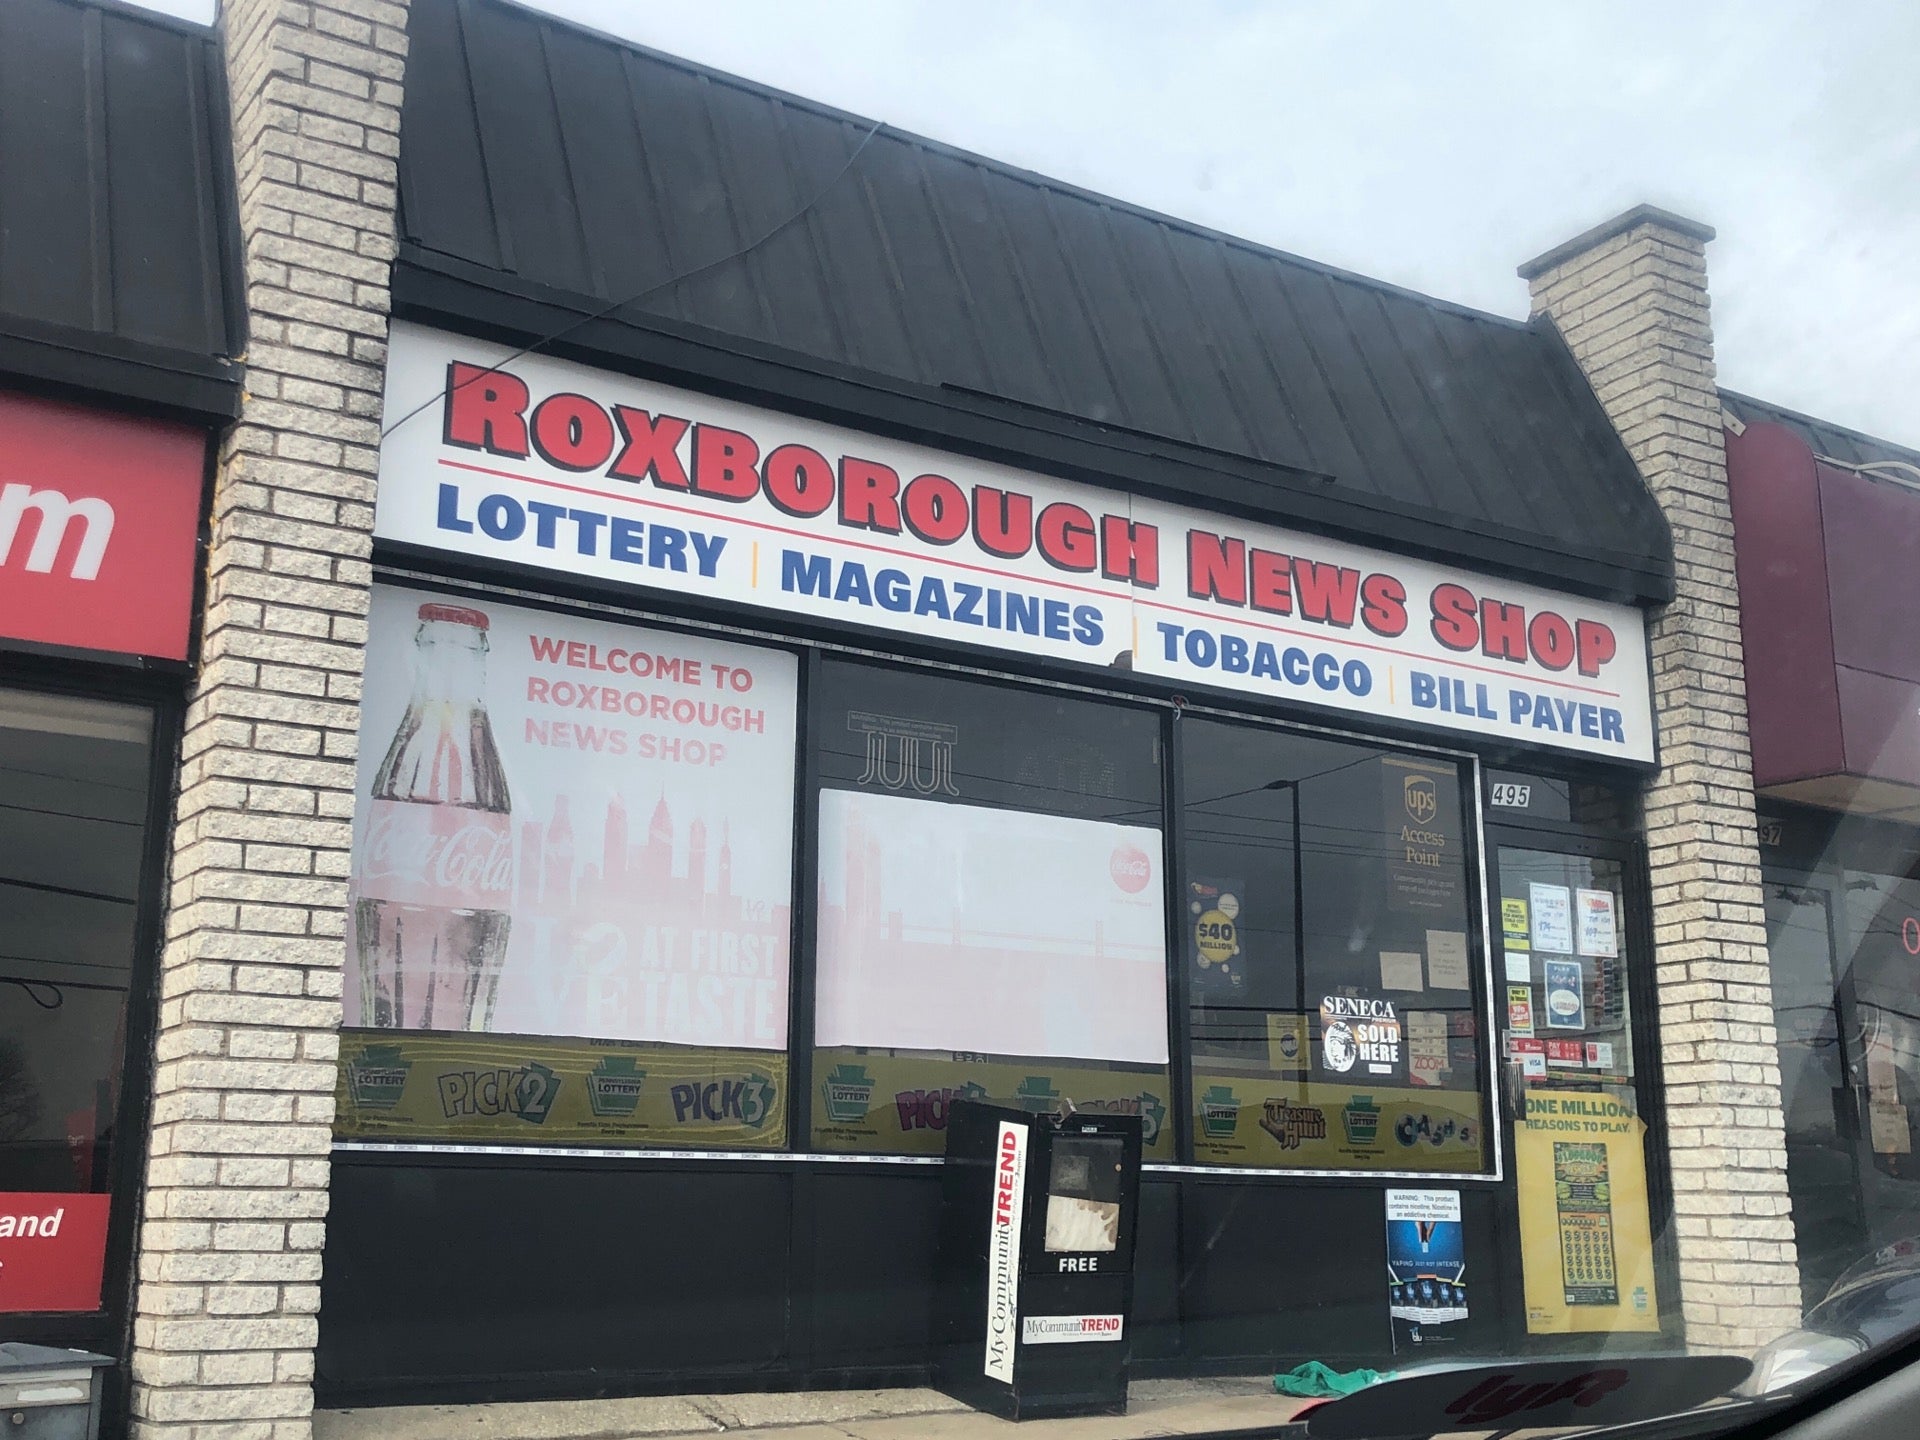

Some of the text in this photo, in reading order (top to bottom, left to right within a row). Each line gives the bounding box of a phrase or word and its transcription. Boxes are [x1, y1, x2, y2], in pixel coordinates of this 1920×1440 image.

[442, 360, 1616, 679] ROXBOROUGH NEWS SHOP
[437, 483, 1625, 744] LOTTERY MAGAZINES TOBACCO BILL PAYER
[529, 635, 753, 692] WELCOME TO
[526, 676, 765, 734] ROXBOROUGH
[525, 718, 727, 768] NEWS SHOP
[857, 730, 960, 796] JUUL
[1407, 789, 1435, 816] ups
[1493, 785, 1528, 806] 495
[1400, 825, 1445, 848] Access
[362, 814, 512, 892] Co-Cola
[1405, 846, 1441, 867] Point
[1198, 921, 1232, 941] $40
[639, 926, 679, 969] AT
[690, 928, 779, 978] FIRST
[1199, 941, 1233, 951] MILLION
[639, 971, 777, 1041] TASTE
[1323, 996, 1396, 1018] SENECA
[1357, 1024, 1398, 1043] SOLD
[1359, 1043, 1399, 1062] HERE
[1414, 1055, 1445, 1070] ZOOM
[358, 1075, 406, 1085] LOTTERY
[598, 1083, 641, 1094] LOTTERY
[832, 1091, 870, 1101] LOTTERY
[1207, 1110, 1238, 1119] LOTTERY
[1264, 1097, 1323, 1123] Treasure
[1526, 1098, 1635, 1119] ONE MILLION
[1350, 1117, 1378, 1126] LOTTERY
[1526, 1119, 1581, 1132] REASONS
[1583, 1121, 1598, 1132] TO
[1280, 1119, 1327, 1150] Hunt
[1435, 1195, 1455, 1203] product
[1059, 1257, 1098, 1272] FREE
[1391, 1260, 1414, 1268] VAPING
[1436, 1260, 1460, 1268] INTENSE
